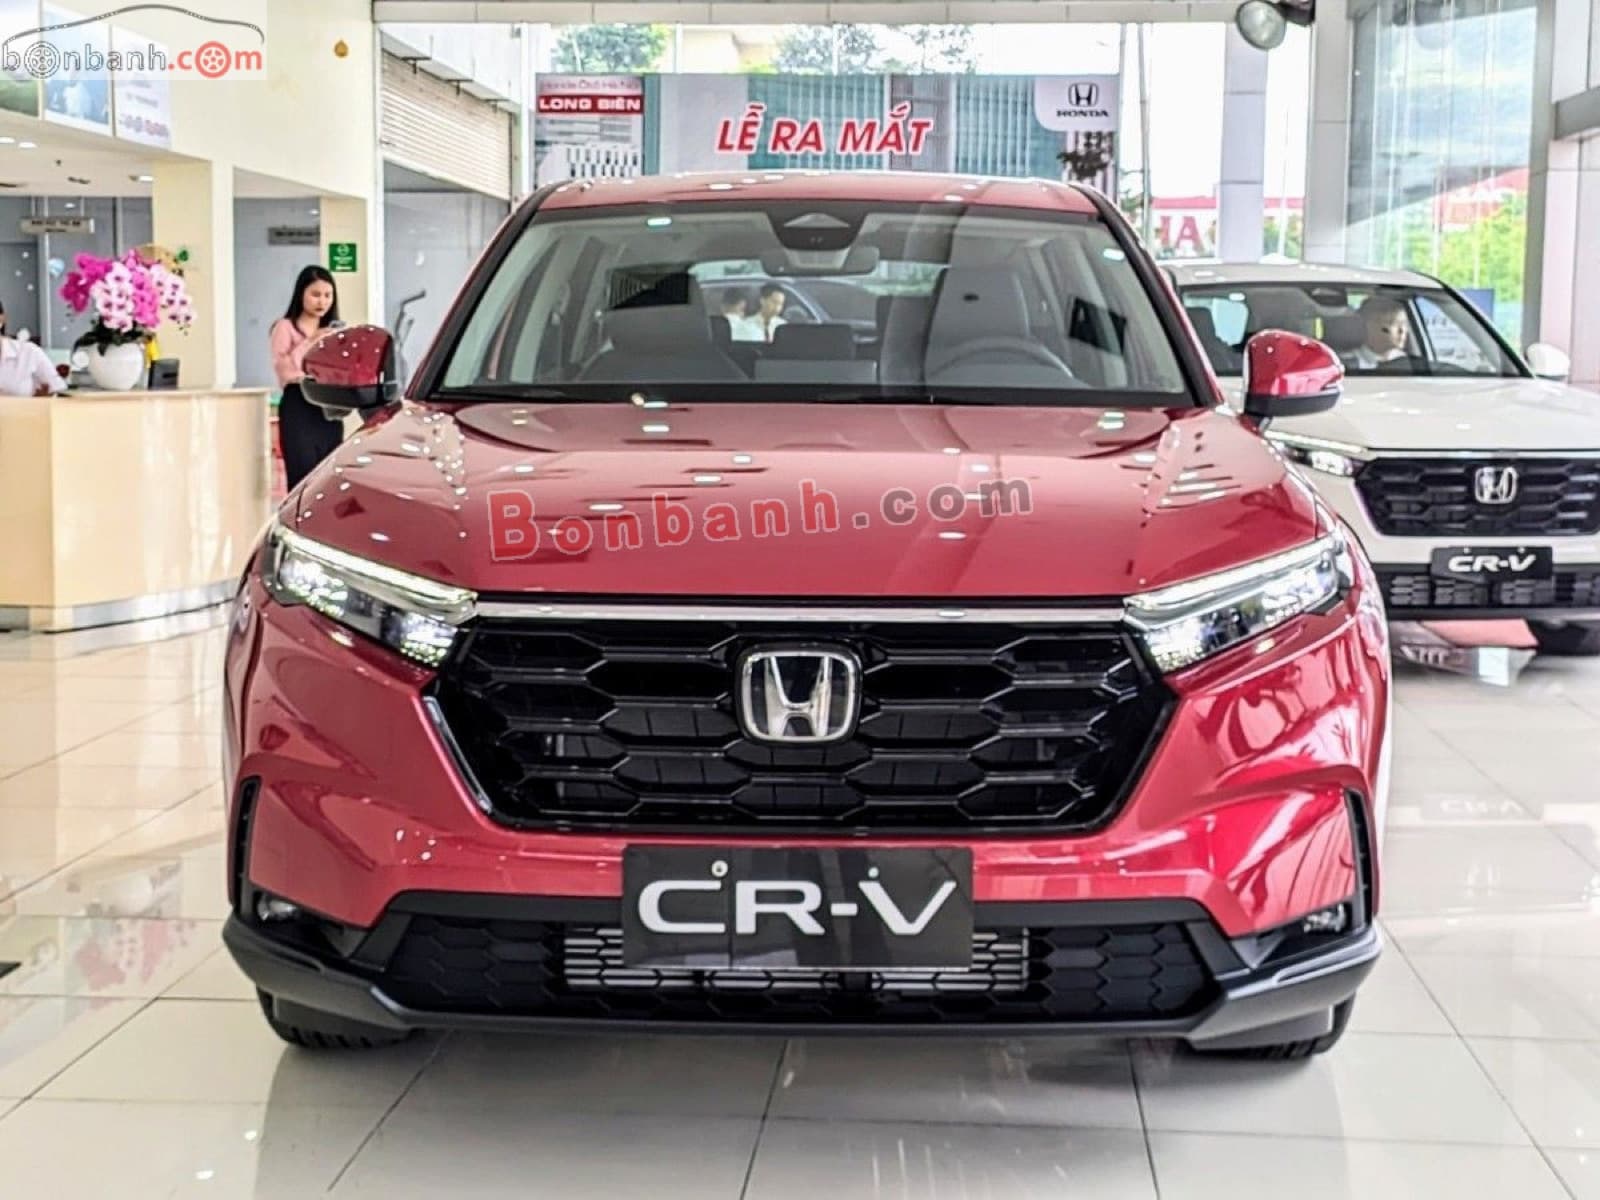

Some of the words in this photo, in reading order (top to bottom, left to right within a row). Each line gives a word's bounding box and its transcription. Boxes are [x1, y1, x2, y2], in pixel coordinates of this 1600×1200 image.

[539, 97, 592, 110] LONG
[597, 96, 641, 110] BIÊN
[1056, 110, 1109, 118] HONDA
[716, 103, 765, 152] LỄ
[769, 120, 824, 152] RA
[838, 103, 931, 152] MẮT
[1448, 554, 1537, 572] CR-V
[638, 880, 957, 934] CR-V
